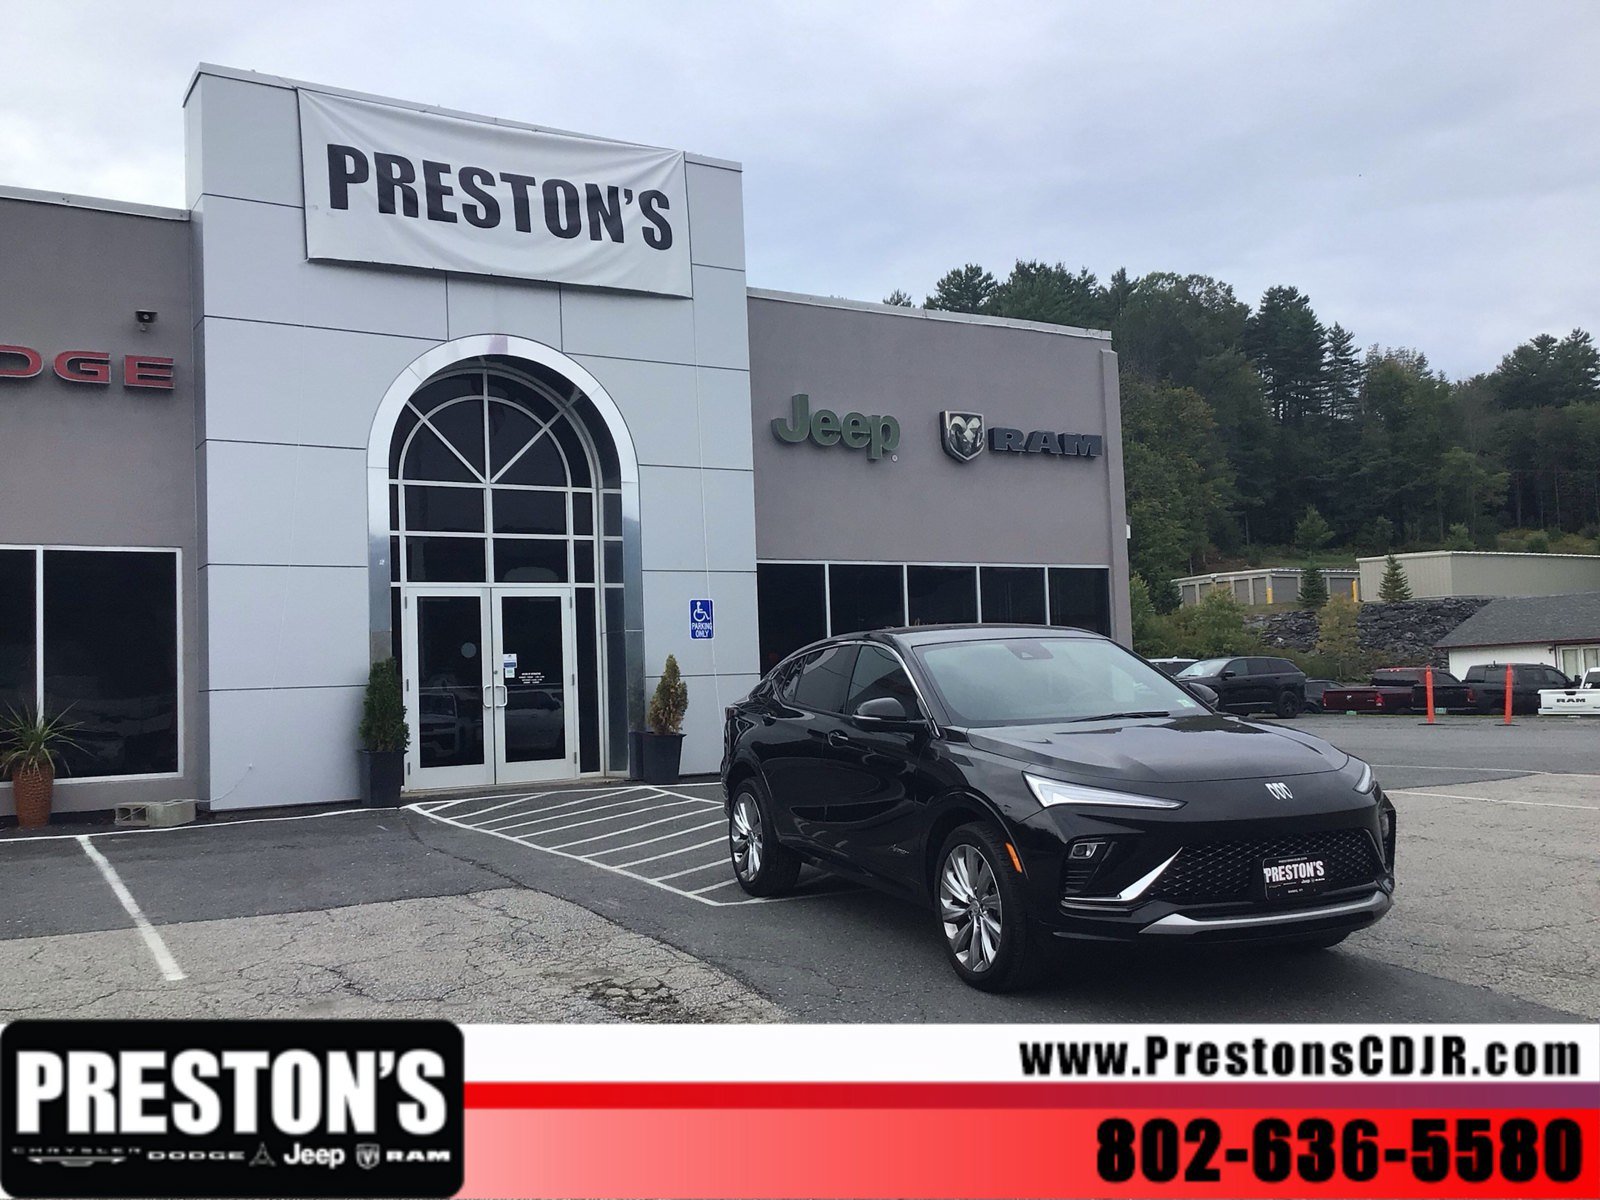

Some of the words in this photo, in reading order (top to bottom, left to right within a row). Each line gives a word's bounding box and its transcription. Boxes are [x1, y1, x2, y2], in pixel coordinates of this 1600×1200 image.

[327, 143, 673, 251] PRESTON'S
[771, 393, 900, 462] Jeep
[988, 427, 1103, 457] RAM
[691, 622, 712, 630] PARKING
[695, 630, 710, 638] ONLY
[1263, 860, 1325, 884] PRESTON'S
